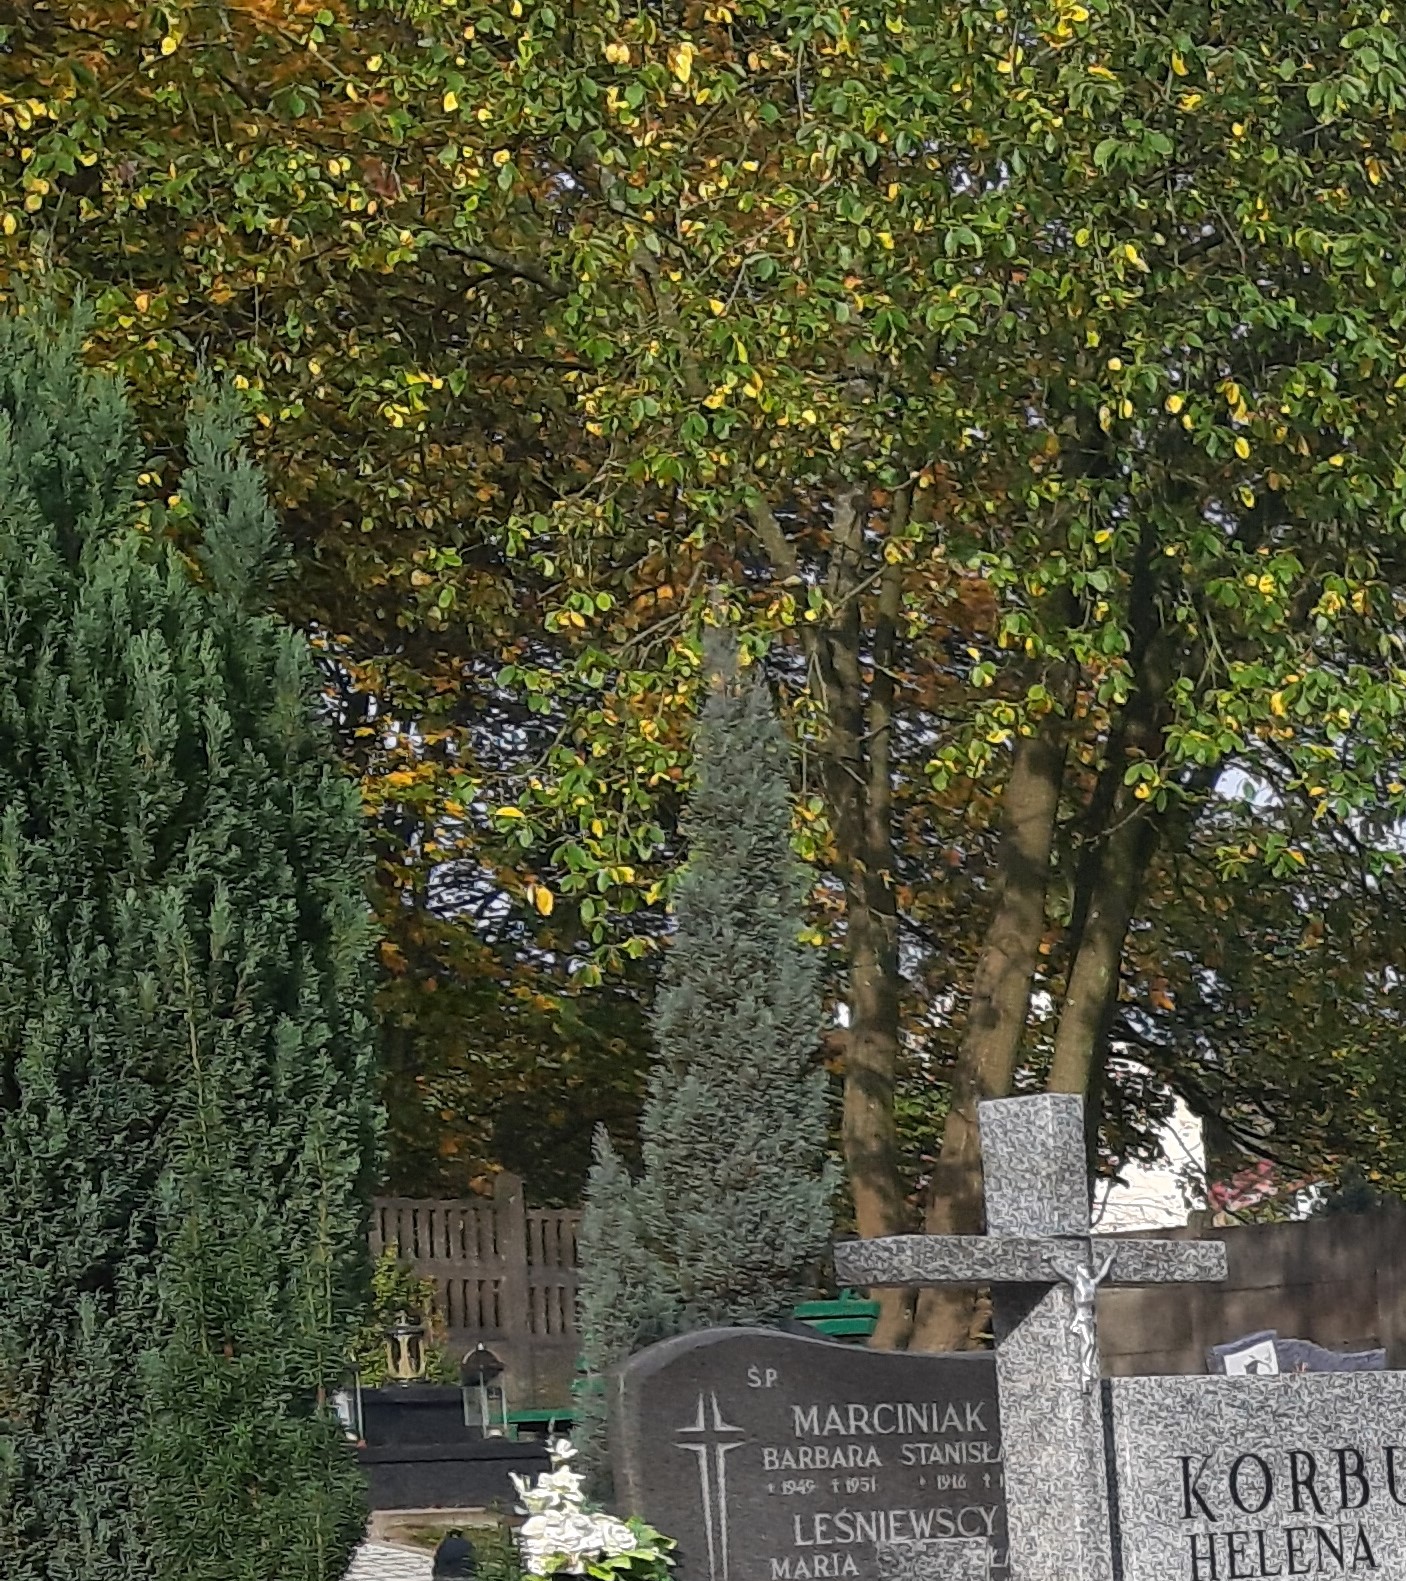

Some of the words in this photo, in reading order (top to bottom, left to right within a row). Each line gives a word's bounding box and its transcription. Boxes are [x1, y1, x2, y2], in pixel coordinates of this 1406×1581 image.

[791, 1402, 988, 1437] MARCINIAK
[763, 1446, 883, 1471] BARBARA
[794, 1506, 999, 1547] LEŚNIEWSCY
[770, 1553, 860, 1581] MARIA
